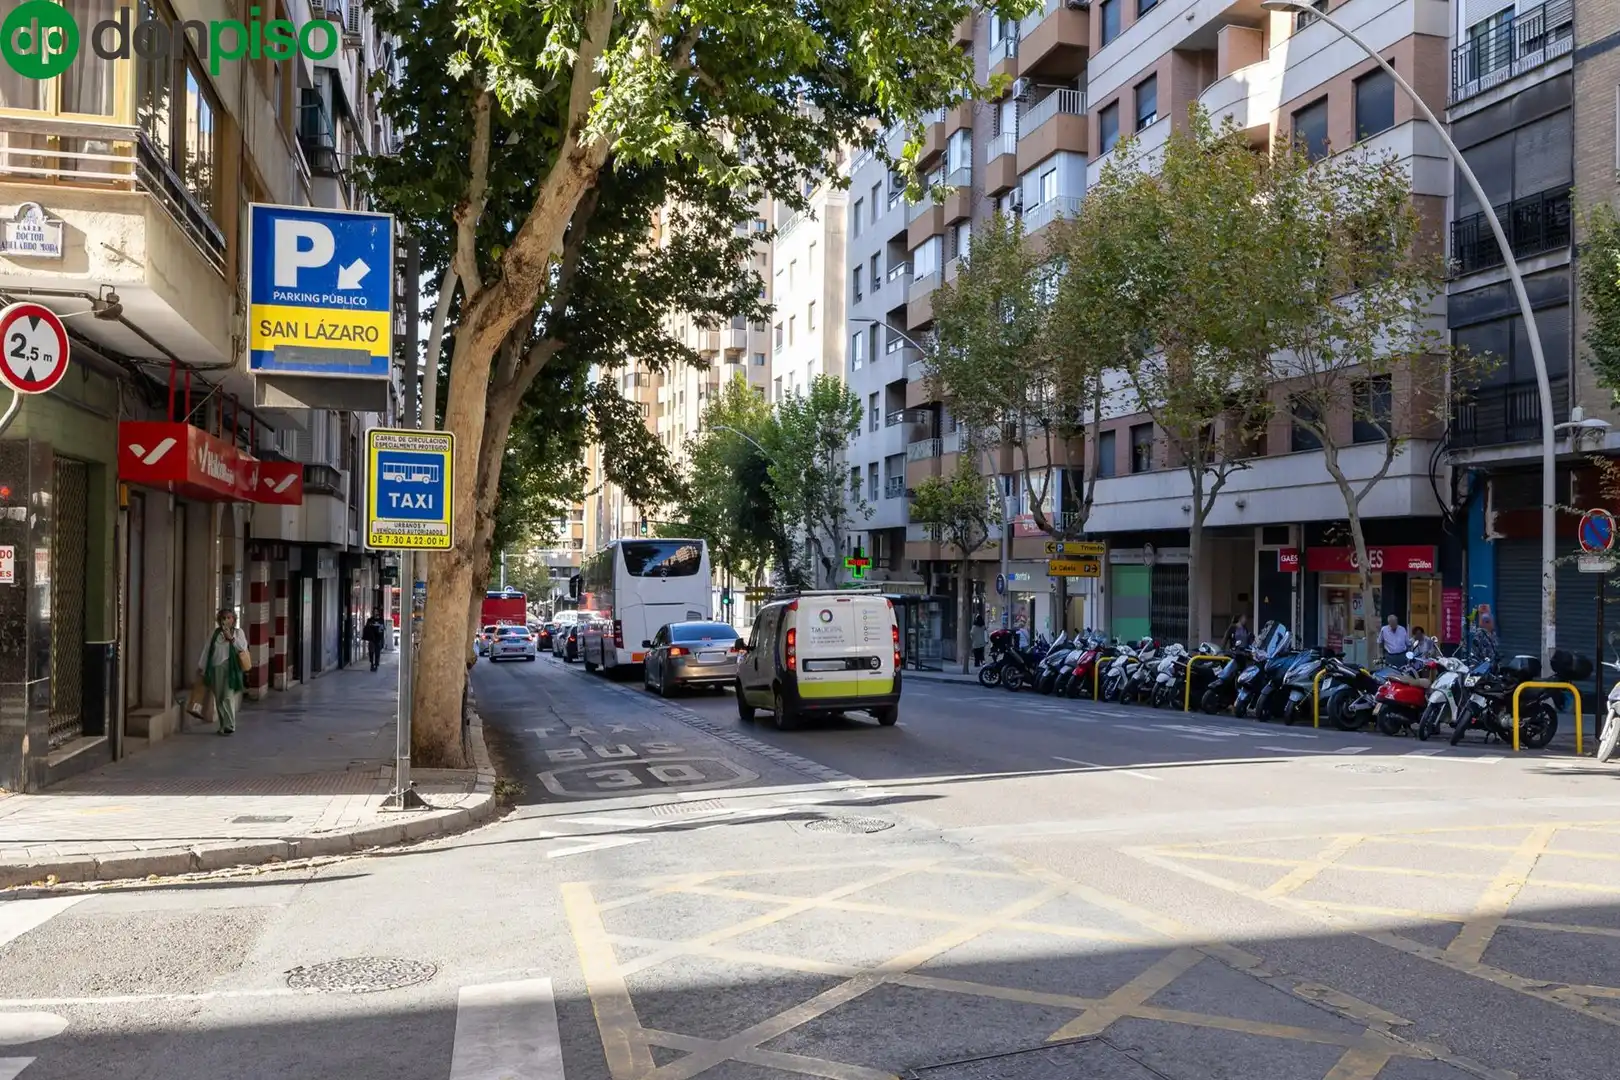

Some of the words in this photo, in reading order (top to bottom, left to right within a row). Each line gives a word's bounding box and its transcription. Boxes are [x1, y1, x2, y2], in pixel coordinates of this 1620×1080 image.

[16, 232, 44, 241] DOCTOR
[274, 218, 336, 288] P
[273, 291, 320, 303] PARKING
[322, 293, 368, 306] PÚBLICO
[260, 319, 298, 338] SAN
[304, 319, 379, 342] LÁZARO
[10, 332, 39, 361] 2,5
[43, 353, 53, 362] m
[418, 443, 448, 451] PROTEGIDO
[388, 492, 433, 509] TAXI
[372, 535, 381, 543] DE
[385, 535, 404, 544] 7:30
[406, 536, 412, 544] A
[414, 536, 437, 545] 22:00
[1280, 554, 1299, 562] GAES
[1350, 550, 1384, 569] GES
[524, 722, 661, 739] TAXI
[545, 742, 687, 761] BUS
[586, 764, 706, 788] 30
